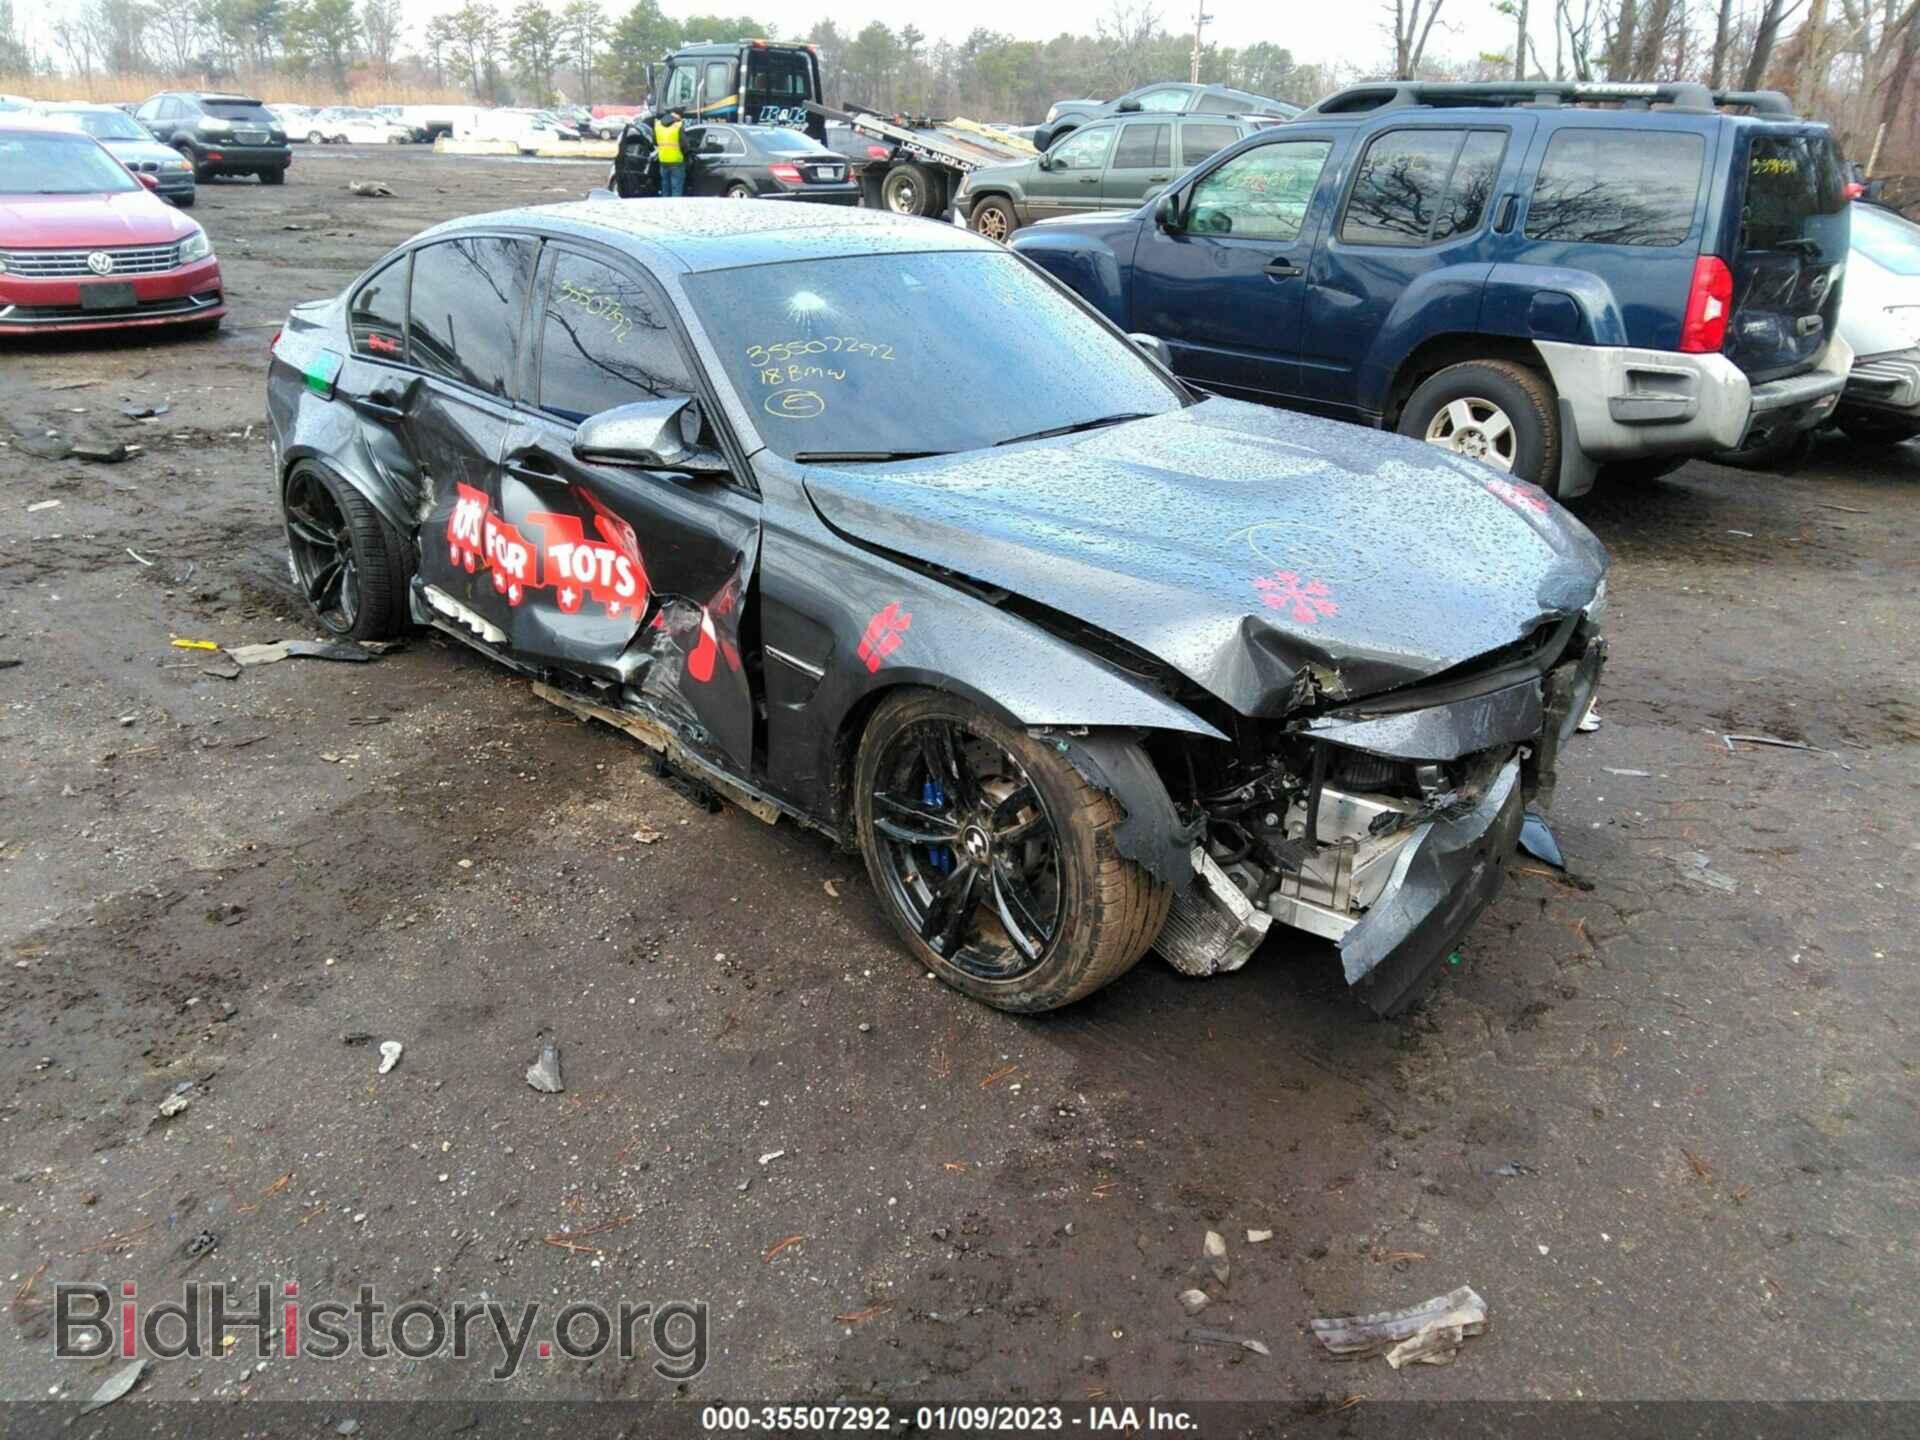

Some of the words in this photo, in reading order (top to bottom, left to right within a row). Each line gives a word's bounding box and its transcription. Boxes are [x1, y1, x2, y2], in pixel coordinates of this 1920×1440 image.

[746, 336, 897, 367] 35507292
[760, 366, 785, 385] 18
[485, 521, 528, 579] FOR
[549, 542, 636, 598] TOTS
